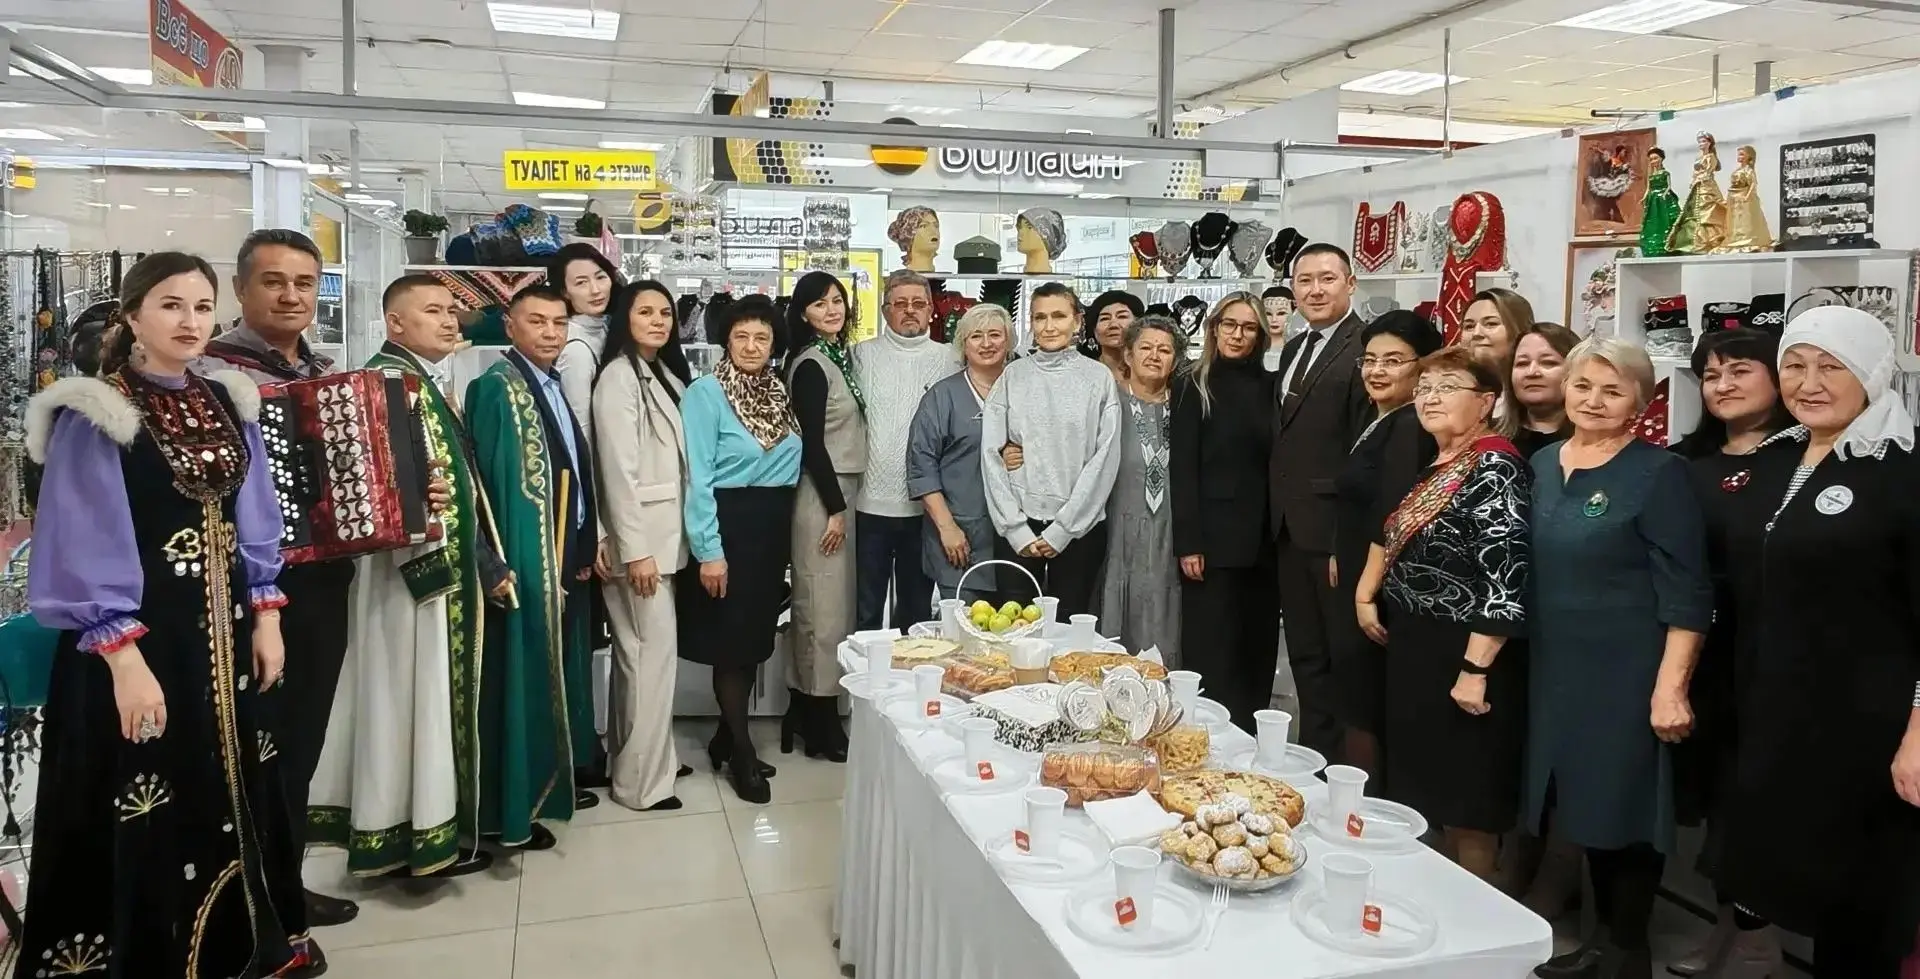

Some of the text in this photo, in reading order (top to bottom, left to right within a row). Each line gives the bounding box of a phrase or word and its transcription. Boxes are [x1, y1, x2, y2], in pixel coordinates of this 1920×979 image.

[156, 0, 188, 54] Всё
[190, 30, 209, 68] по
[511, 160, 651, 182] ТУАЛЕТ на 4 этаже
